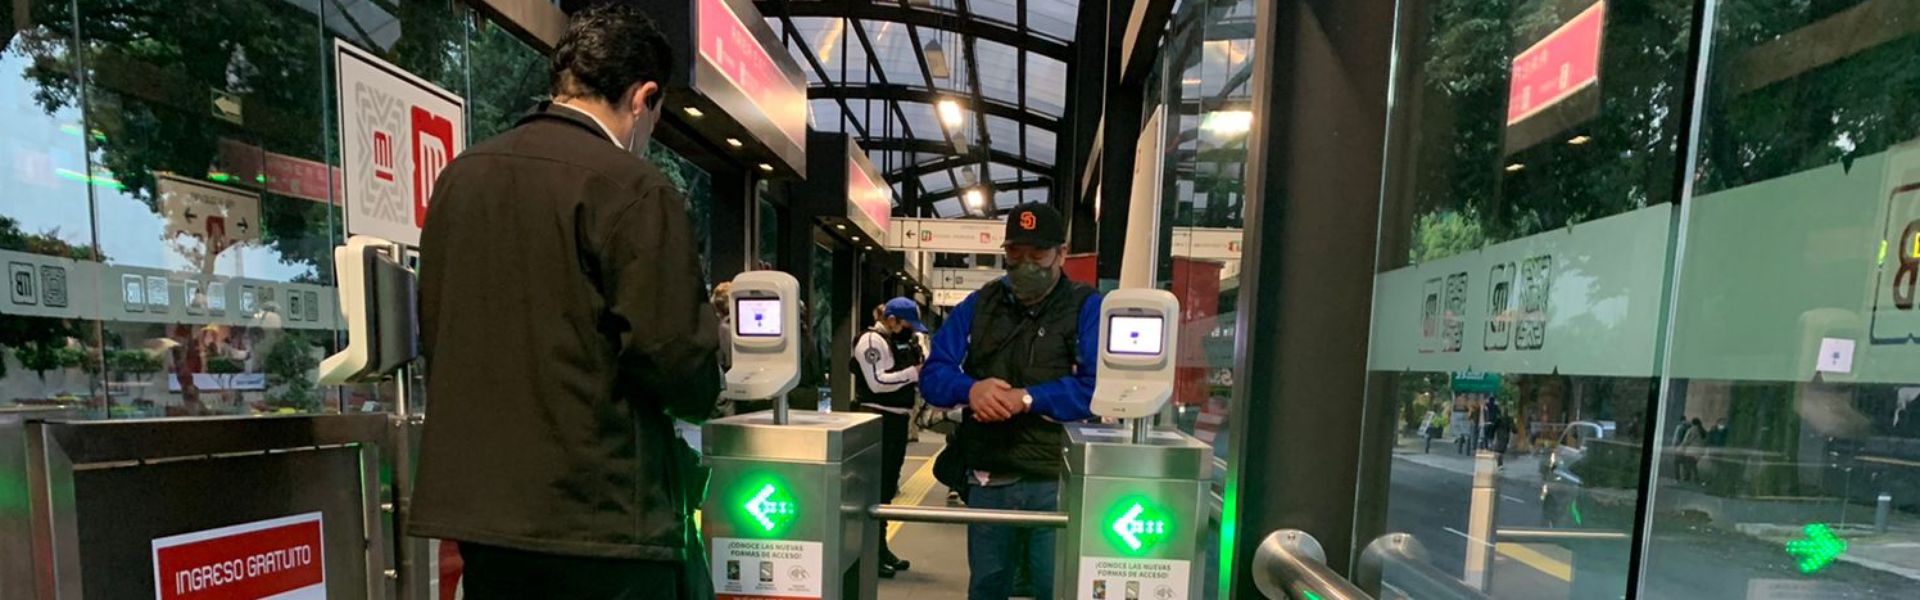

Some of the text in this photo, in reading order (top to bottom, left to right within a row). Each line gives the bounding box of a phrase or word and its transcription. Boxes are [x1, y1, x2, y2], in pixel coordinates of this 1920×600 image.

[776, 544, 804, 552] NUEVAS
[730, 550, 760, 558] FORMAS
[175, 544, 312, 596] INGRESO GRATUITO
